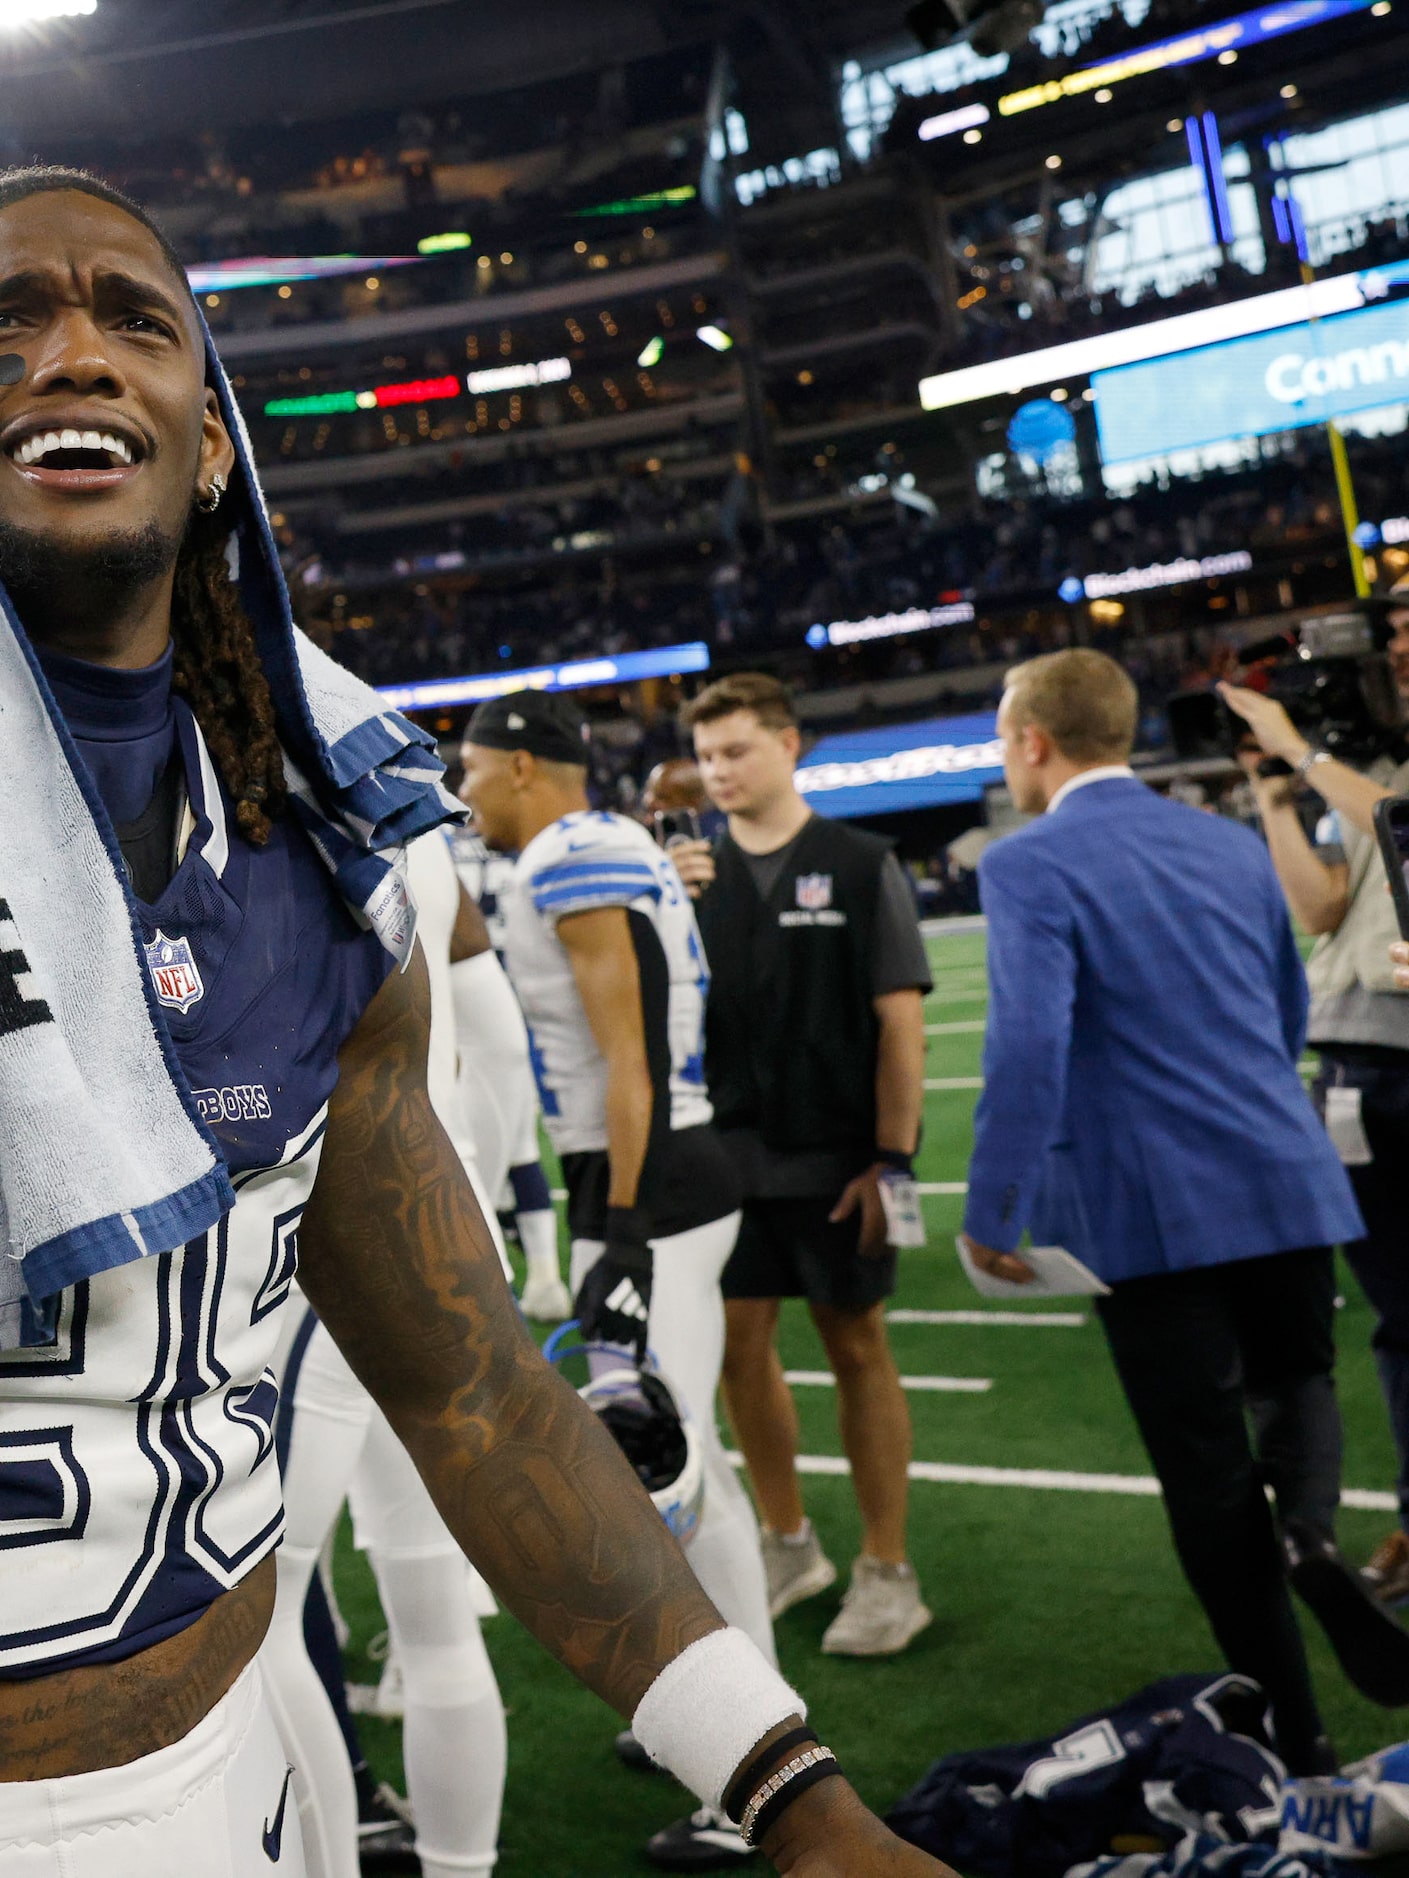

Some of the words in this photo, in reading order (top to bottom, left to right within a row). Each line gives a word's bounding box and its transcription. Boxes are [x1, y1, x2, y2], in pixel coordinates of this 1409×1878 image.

[1265, 338, 1409, 403] Conn
[371, 880, 401, 921] Fanatics
[155, 964, 196, 999] NFL
[191, 1084, 272, 1124] BOYS
